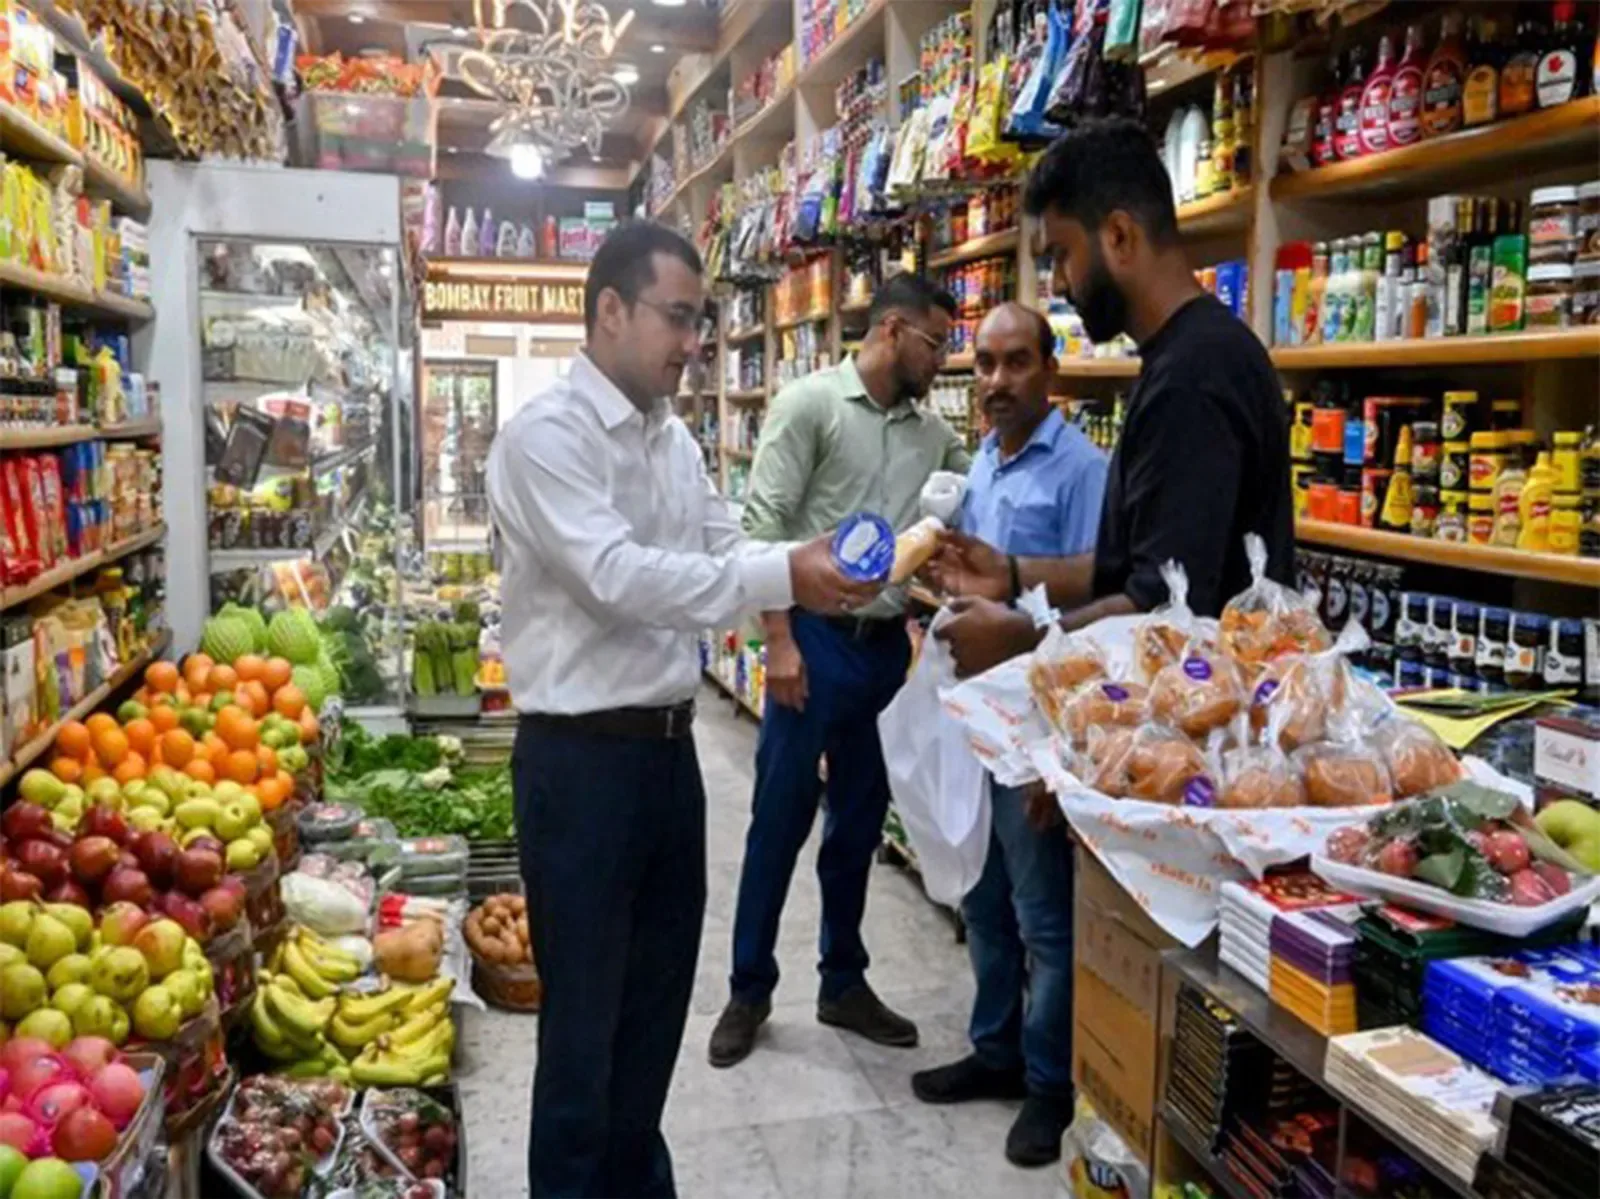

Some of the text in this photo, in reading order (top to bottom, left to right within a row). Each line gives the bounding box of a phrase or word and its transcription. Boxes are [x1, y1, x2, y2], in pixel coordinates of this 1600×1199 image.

[425, 282, 585, 315] BOMBAY FRUIT MART
